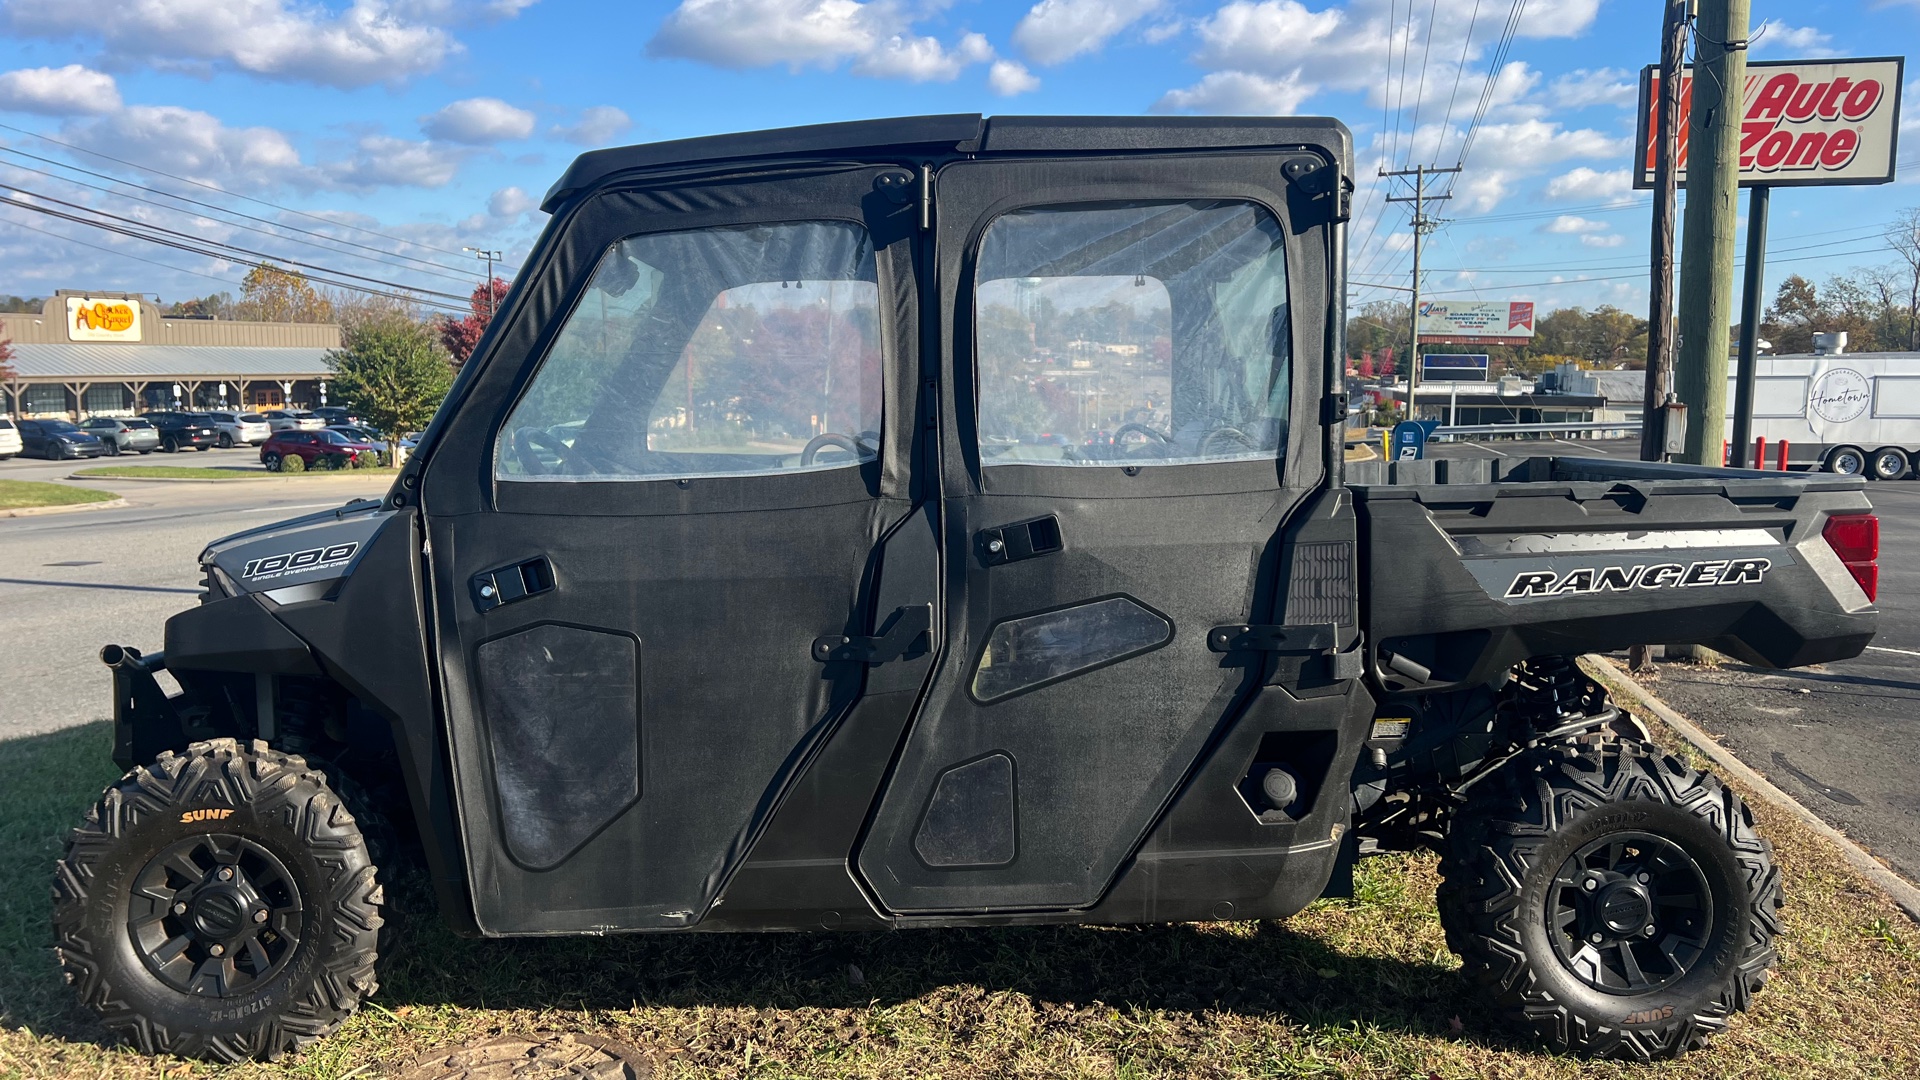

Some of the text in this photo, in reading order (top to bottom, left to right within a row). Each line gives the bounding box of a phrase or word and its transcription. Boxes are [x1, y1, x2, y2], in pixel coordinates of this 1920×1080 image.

[1744, 72, 1881, 120] Auto
[1739, 121, 1859, 169] Zone
[1824, 370, 1862, 382] HANDCRAFTED
[1810, 388, 1870, 409] Hometown
[242, 541, 359, 578] 1000
[252, 560, 350, 581] SINGLE OVERHEAD CAM
[1504, 557, 1772, 598] RANGER
[179, 808, 235, 824] SUNF
[1621, 1004, 1677, 1024] SUNF
